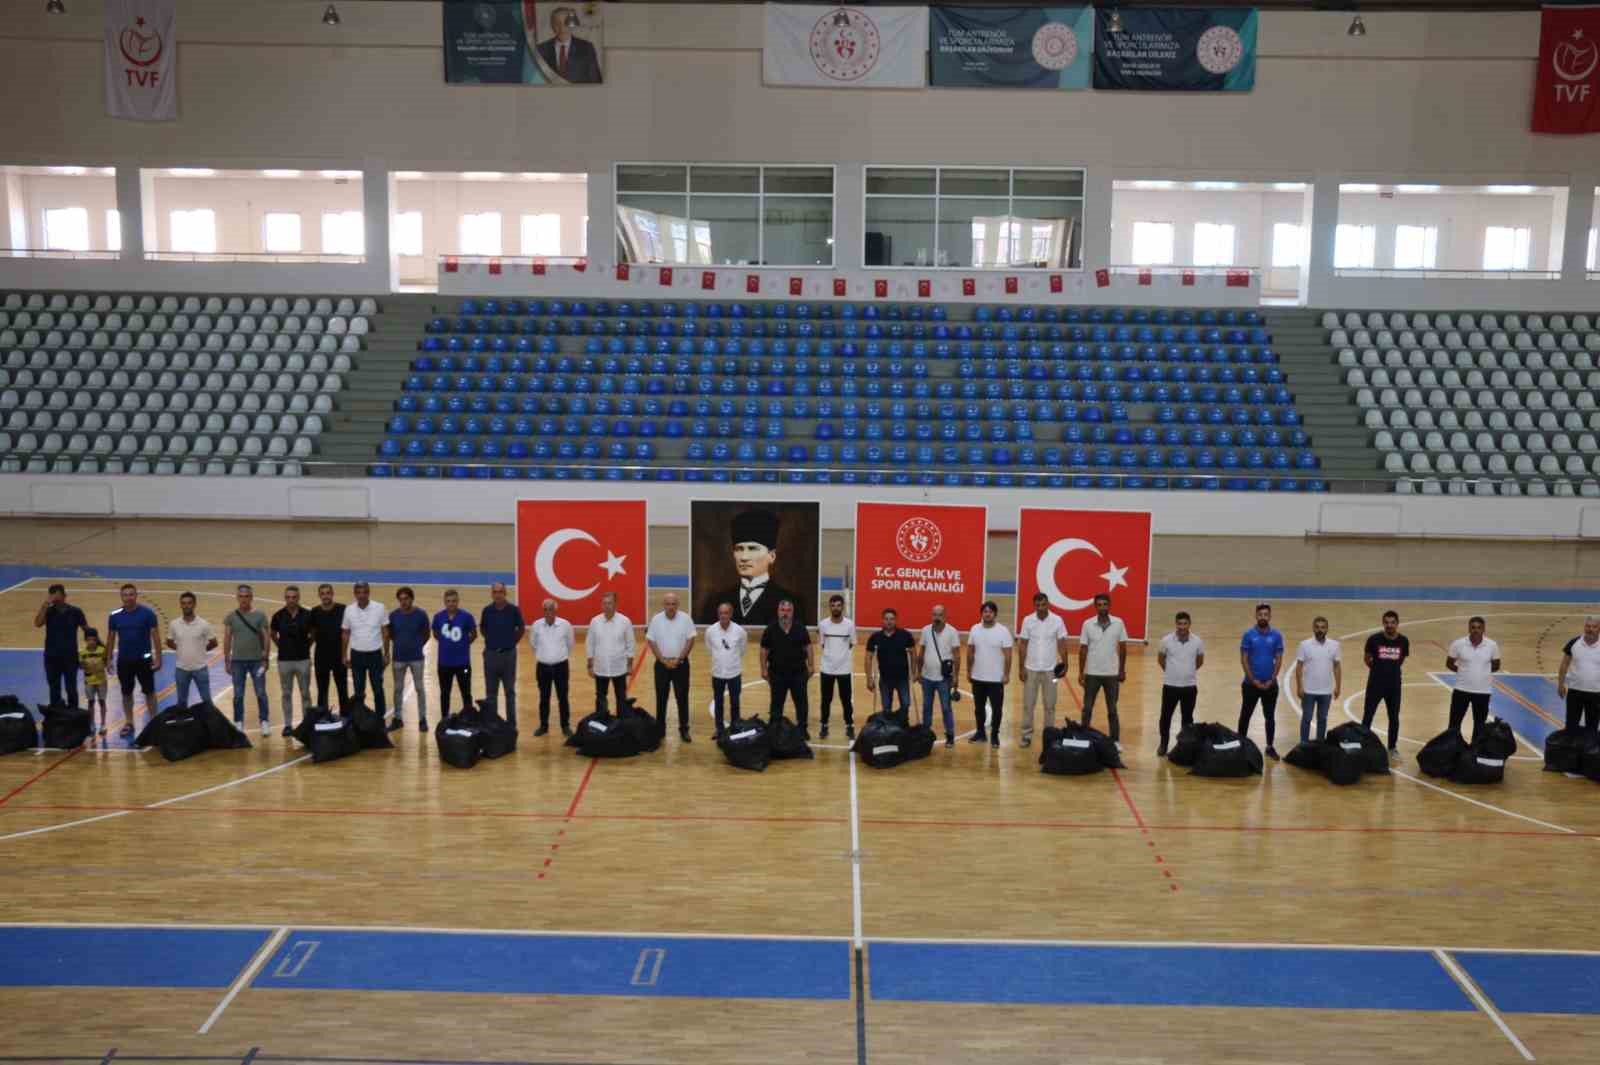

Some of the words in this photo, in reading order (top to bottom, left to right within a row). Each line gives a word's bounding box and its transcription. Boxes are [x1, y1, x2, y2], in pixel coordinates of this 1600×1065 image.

[125, 68, 160, 88] TVF
[1553, 84, 1592, 103] TVF
[874, 566, 895, 578] T.C.
[897, 567, 945, 581] GENÇLİK
[946, 570, 961, 580] VE
[871, 579, 901, 590] SPOR
[903, 580, 964, 593] BAKANLIĞI
[441, 623, 462, 642] 40
